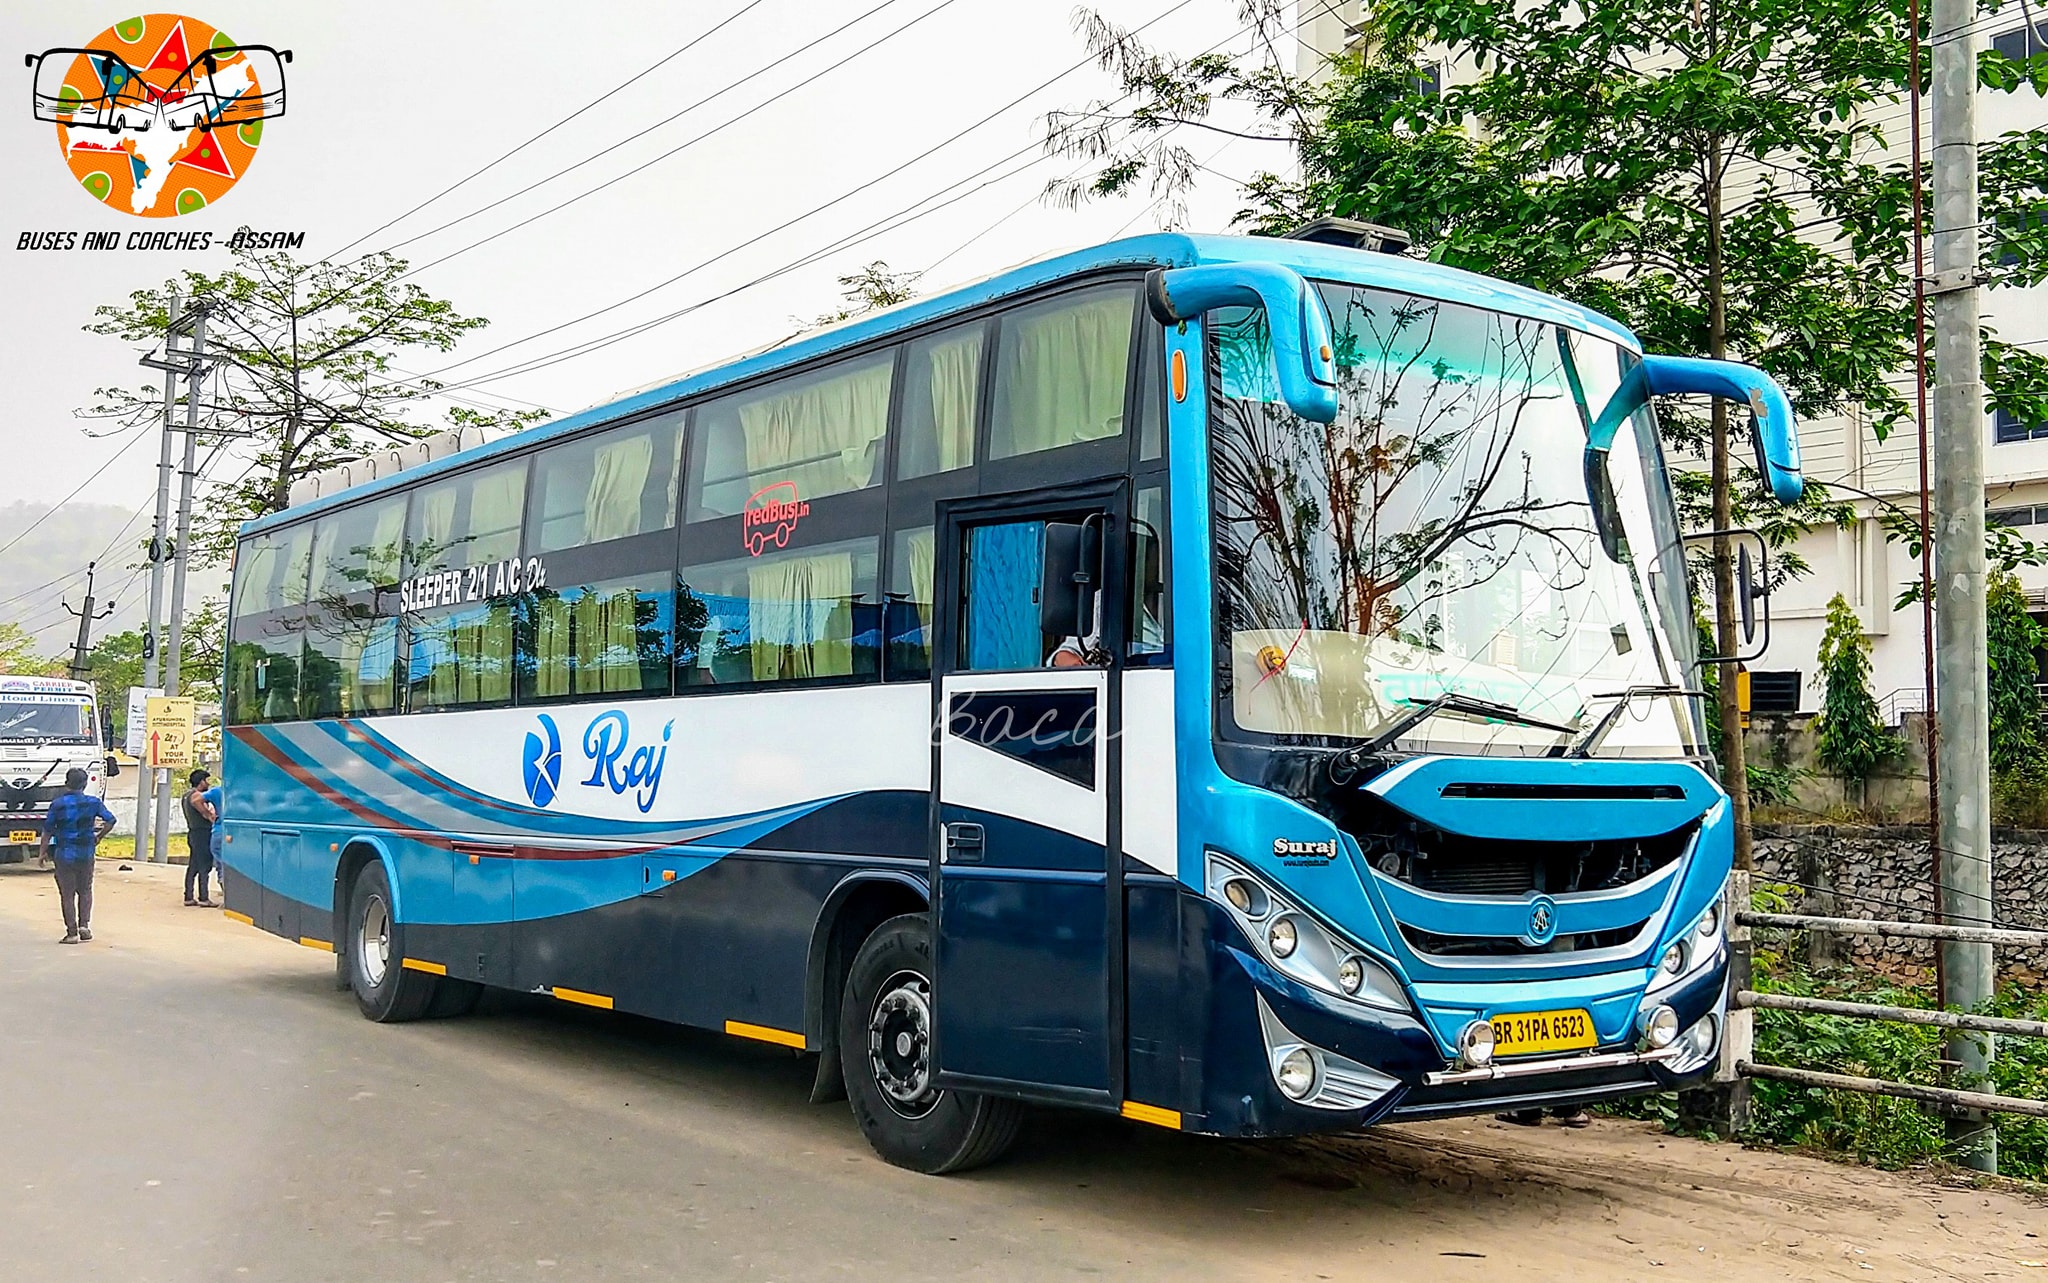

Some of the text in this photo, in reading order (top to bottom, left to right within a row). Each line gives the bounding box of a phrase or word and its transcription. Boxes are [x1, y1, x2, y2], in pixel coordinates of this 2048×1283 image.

[747, 499, 809, 527] redBus.in
[400, 570, 461, 613] SLEEPER
[466, 565, 489, 601] 2/1
[493, 557, 522, 597] A/C
[32, 680, 73, 688] CARRIER
[580, 709, 676, 813] Raj
[1273, 838, 1336, 858] Suraj
[1494, 1015, 1585, 1044] BR 31PA 6523
